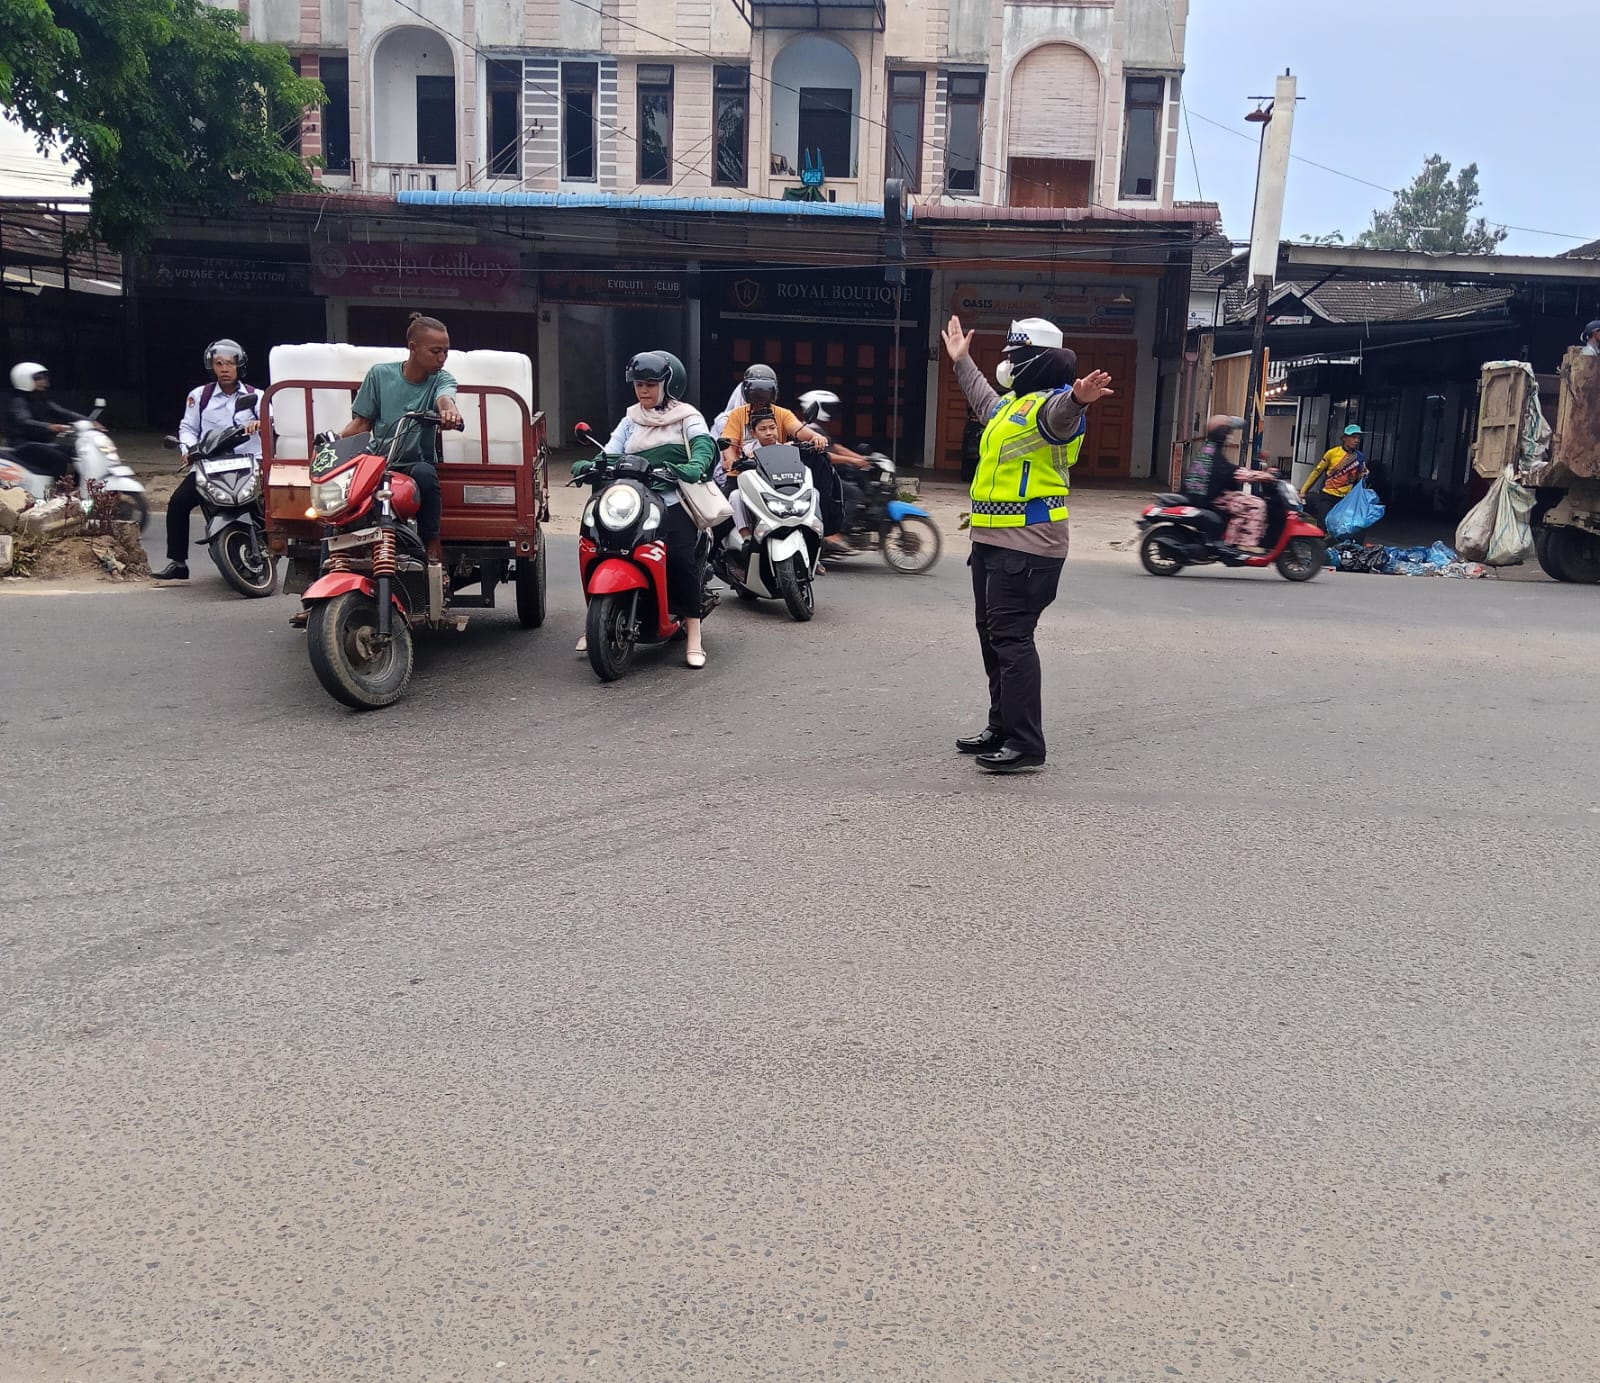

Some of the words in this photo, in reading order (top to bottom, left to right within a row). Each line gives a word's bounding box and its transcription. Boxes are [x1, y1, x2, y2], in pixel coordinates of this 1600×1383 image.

[175, 268, 214, 280] VOYAGE
[217, 270, 285, 281] PLAYSTATION
[776, 282, 829, 299] ROYAL
[963, 298, 993, 309] OASIS
